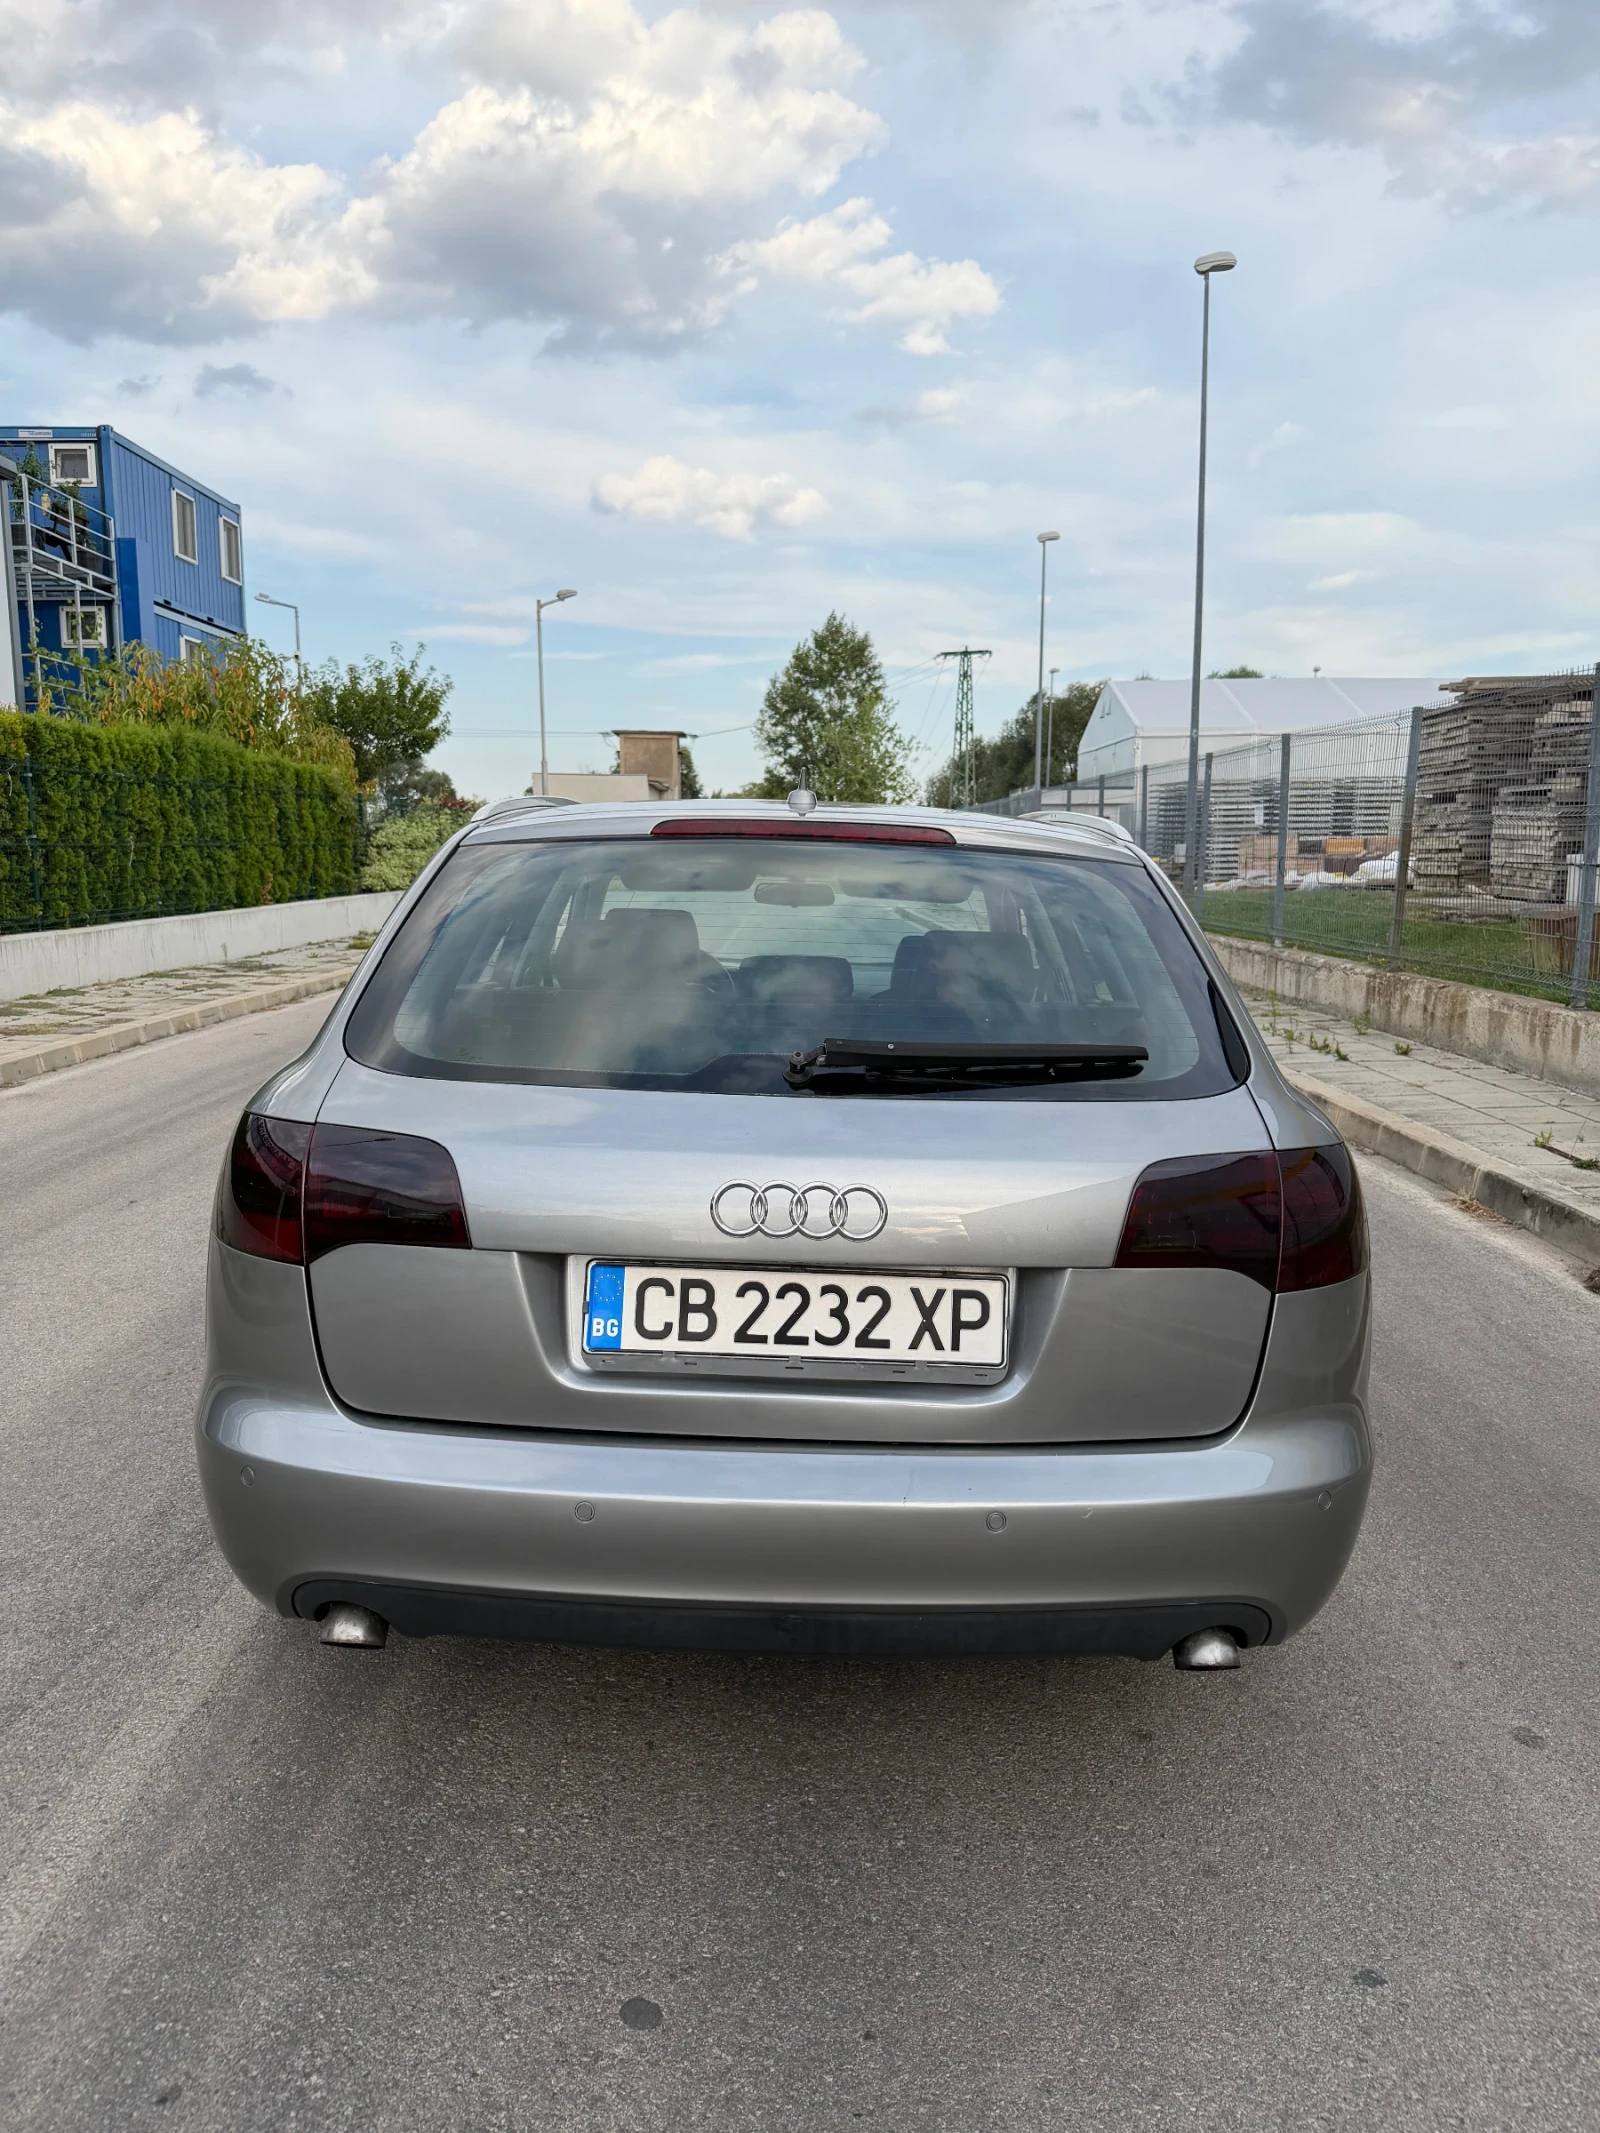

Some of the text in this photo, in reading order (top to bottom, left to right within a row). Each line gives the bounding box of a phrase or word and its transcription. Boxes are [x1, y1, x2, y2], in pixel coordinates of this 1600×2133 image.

[592, 1317, 619, 1337] BG
[635, 1277, 990, 1352] CB 2232 XP
